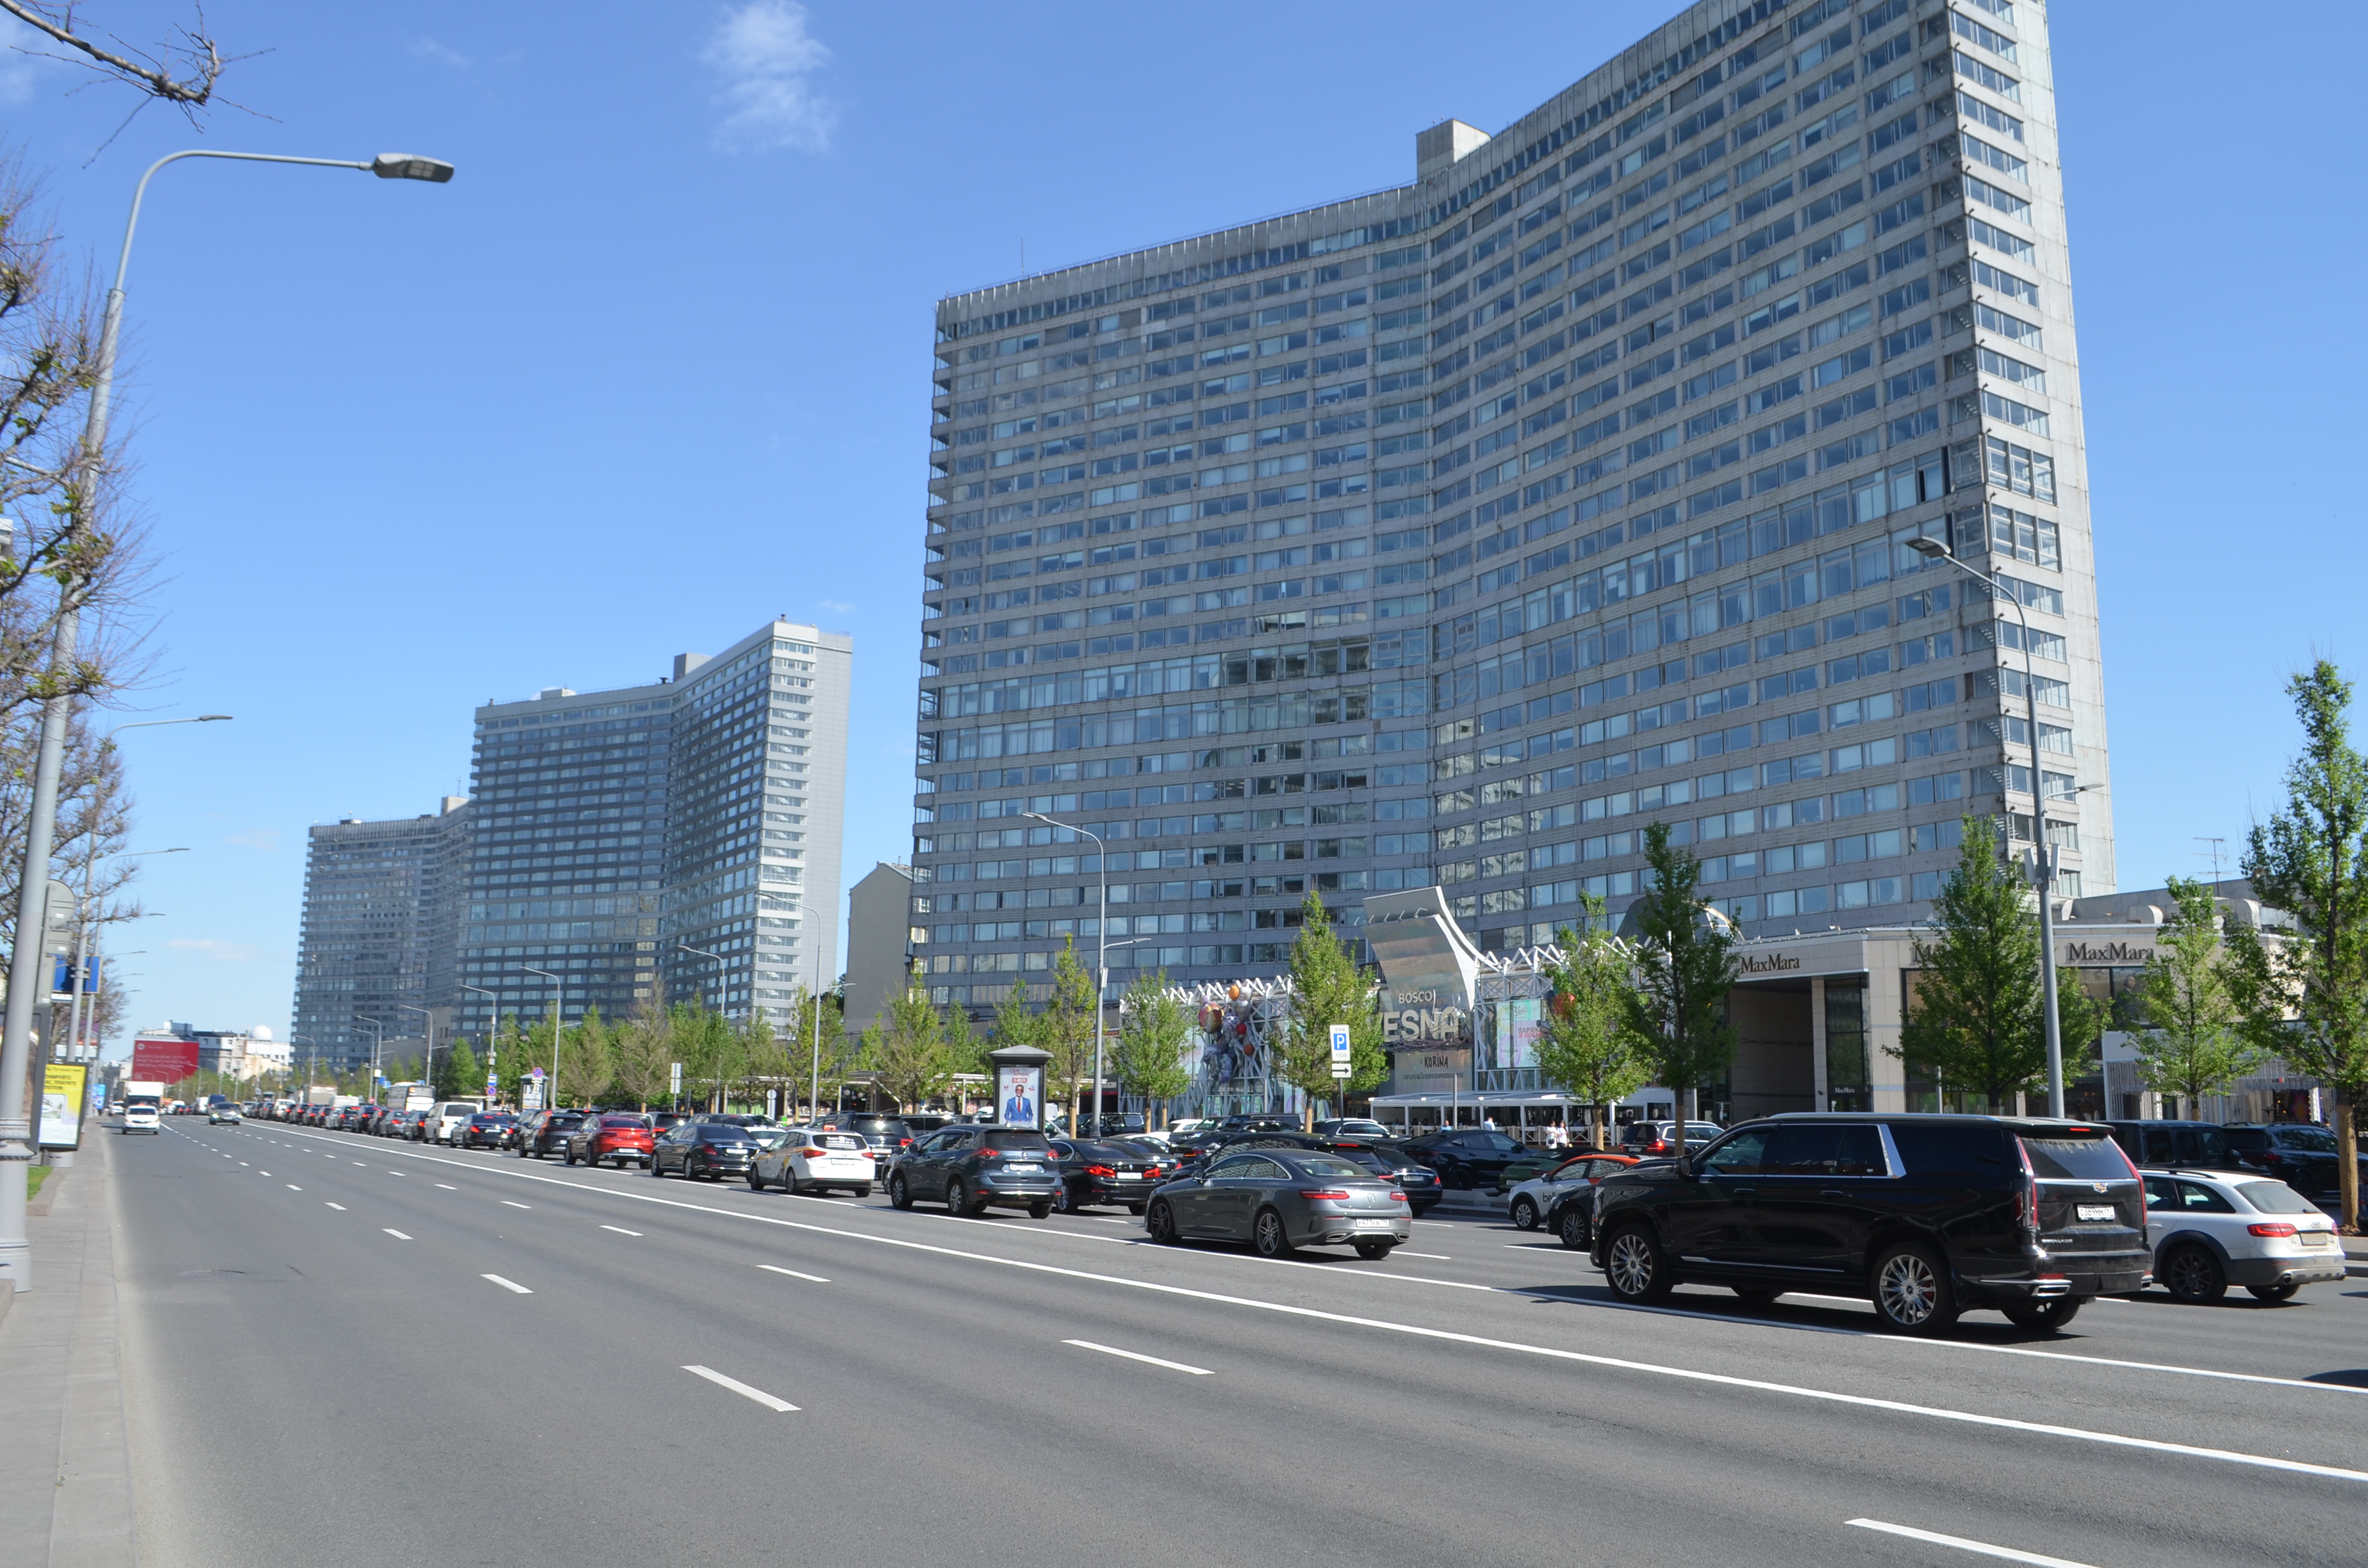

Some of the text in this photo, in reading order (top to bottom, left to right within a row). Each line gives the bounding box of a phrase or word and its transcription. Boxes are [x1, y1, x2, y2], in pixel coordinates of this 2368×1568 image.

[2068, 942, 2153, 961] MaxMara
[1741, 953, 1800, 973] MaxMara
[1399, 991, 1433, 1004] BOSCO
[1379, 1006, 1459, 1042] ESNA
